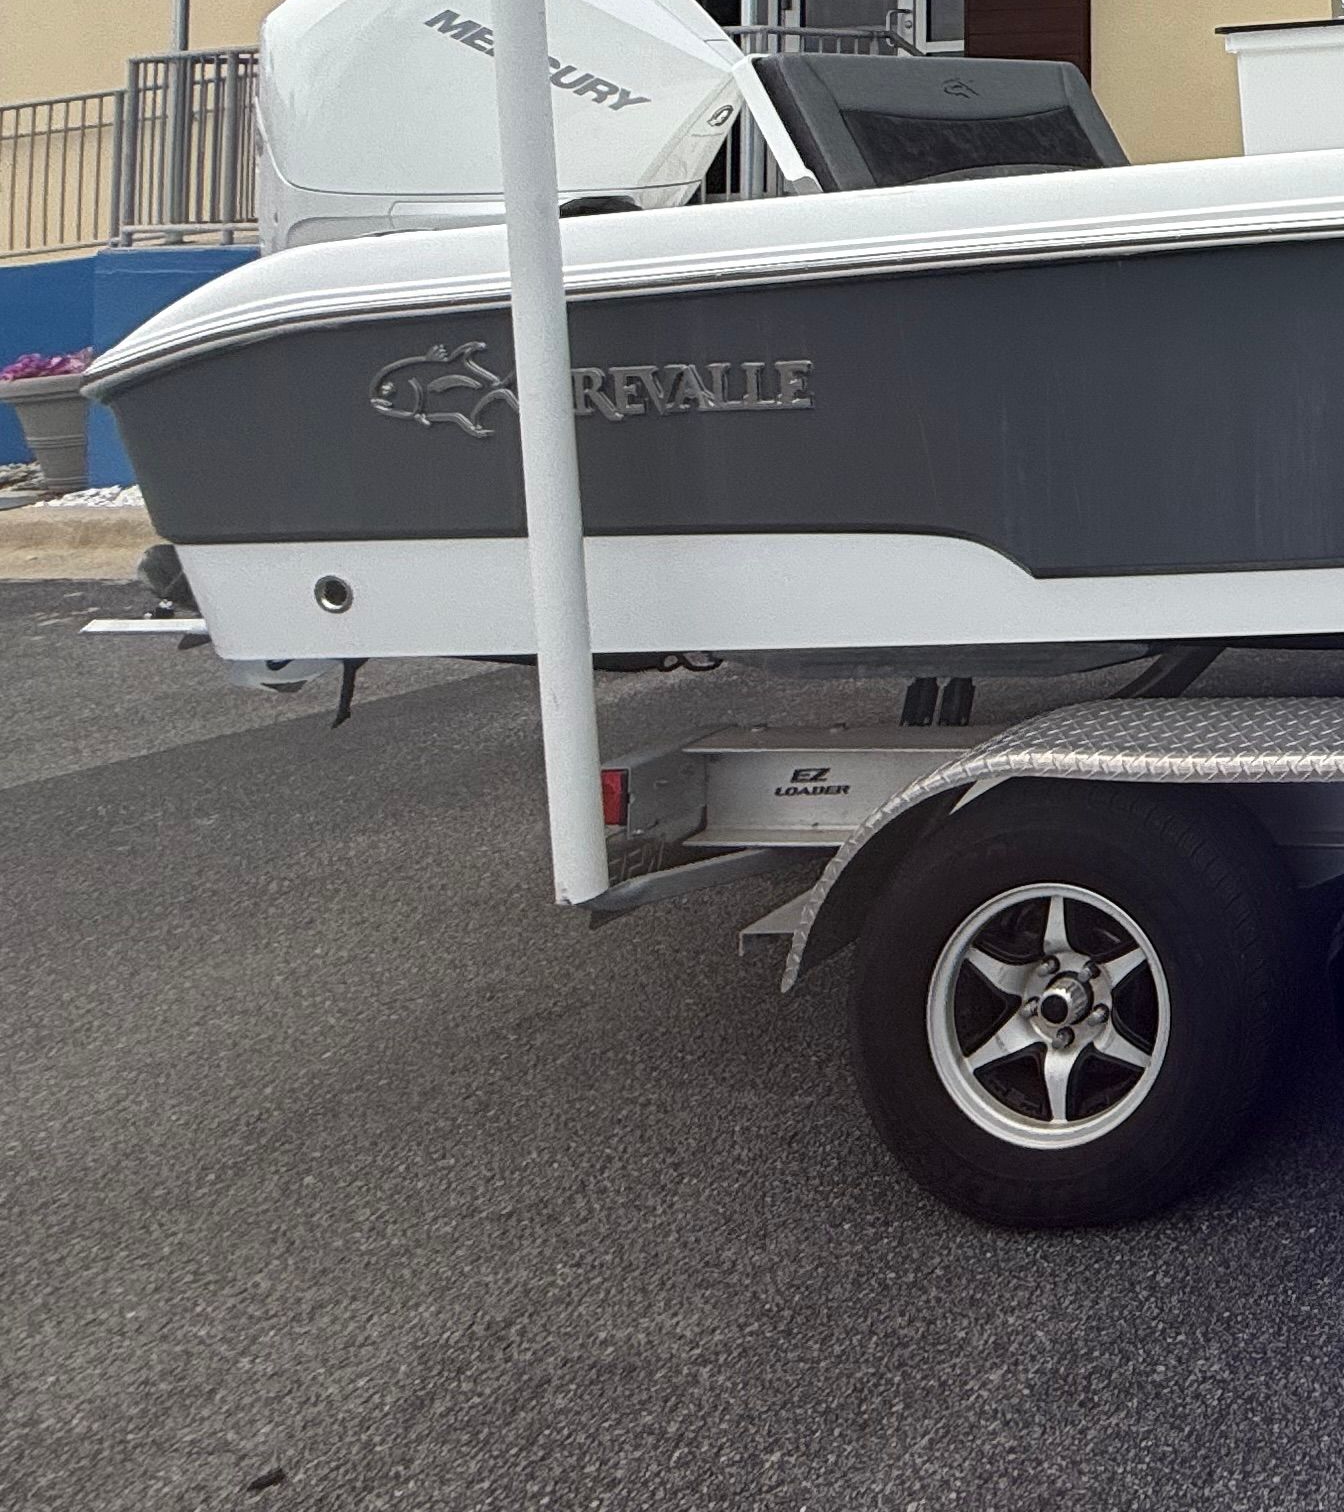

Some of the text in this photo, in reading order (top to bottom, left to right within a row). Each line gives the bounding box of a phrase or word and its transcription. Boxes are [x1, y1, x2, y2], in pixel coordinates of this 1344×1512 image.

[570, 359, 816, 422] REVALLE
[790, 767, 831, 784] EZ
[774, 784, 850, 797] LOADER
